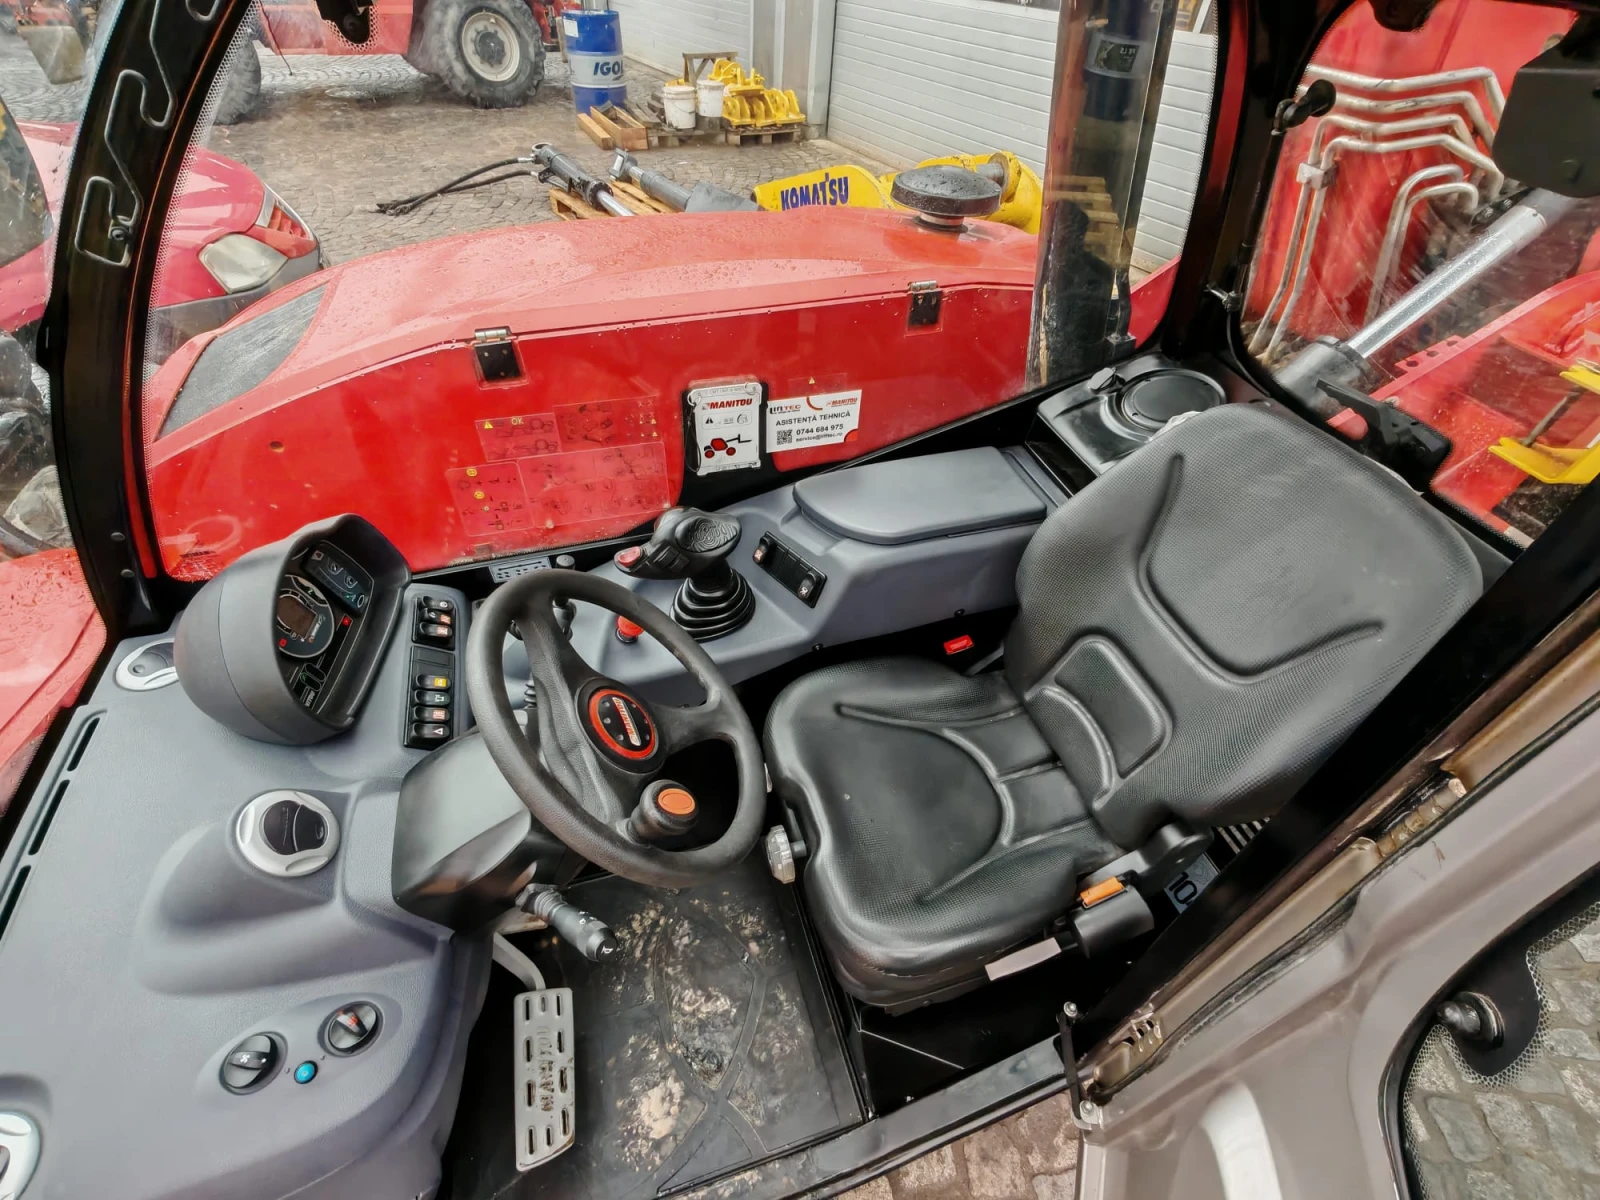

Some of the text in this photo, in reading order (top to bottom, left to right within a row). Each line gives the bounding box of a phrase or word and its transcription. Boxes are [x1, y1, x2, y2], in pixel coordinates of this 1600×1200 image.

[780, 172, 849, 211] KOMATSU
[709, 398, 753, 410] MANITOU
[511, 417, 524, 425] OK
[796, 423, 844, 436] 0744 684 975
[1168, 870, 1198, 906] 10
